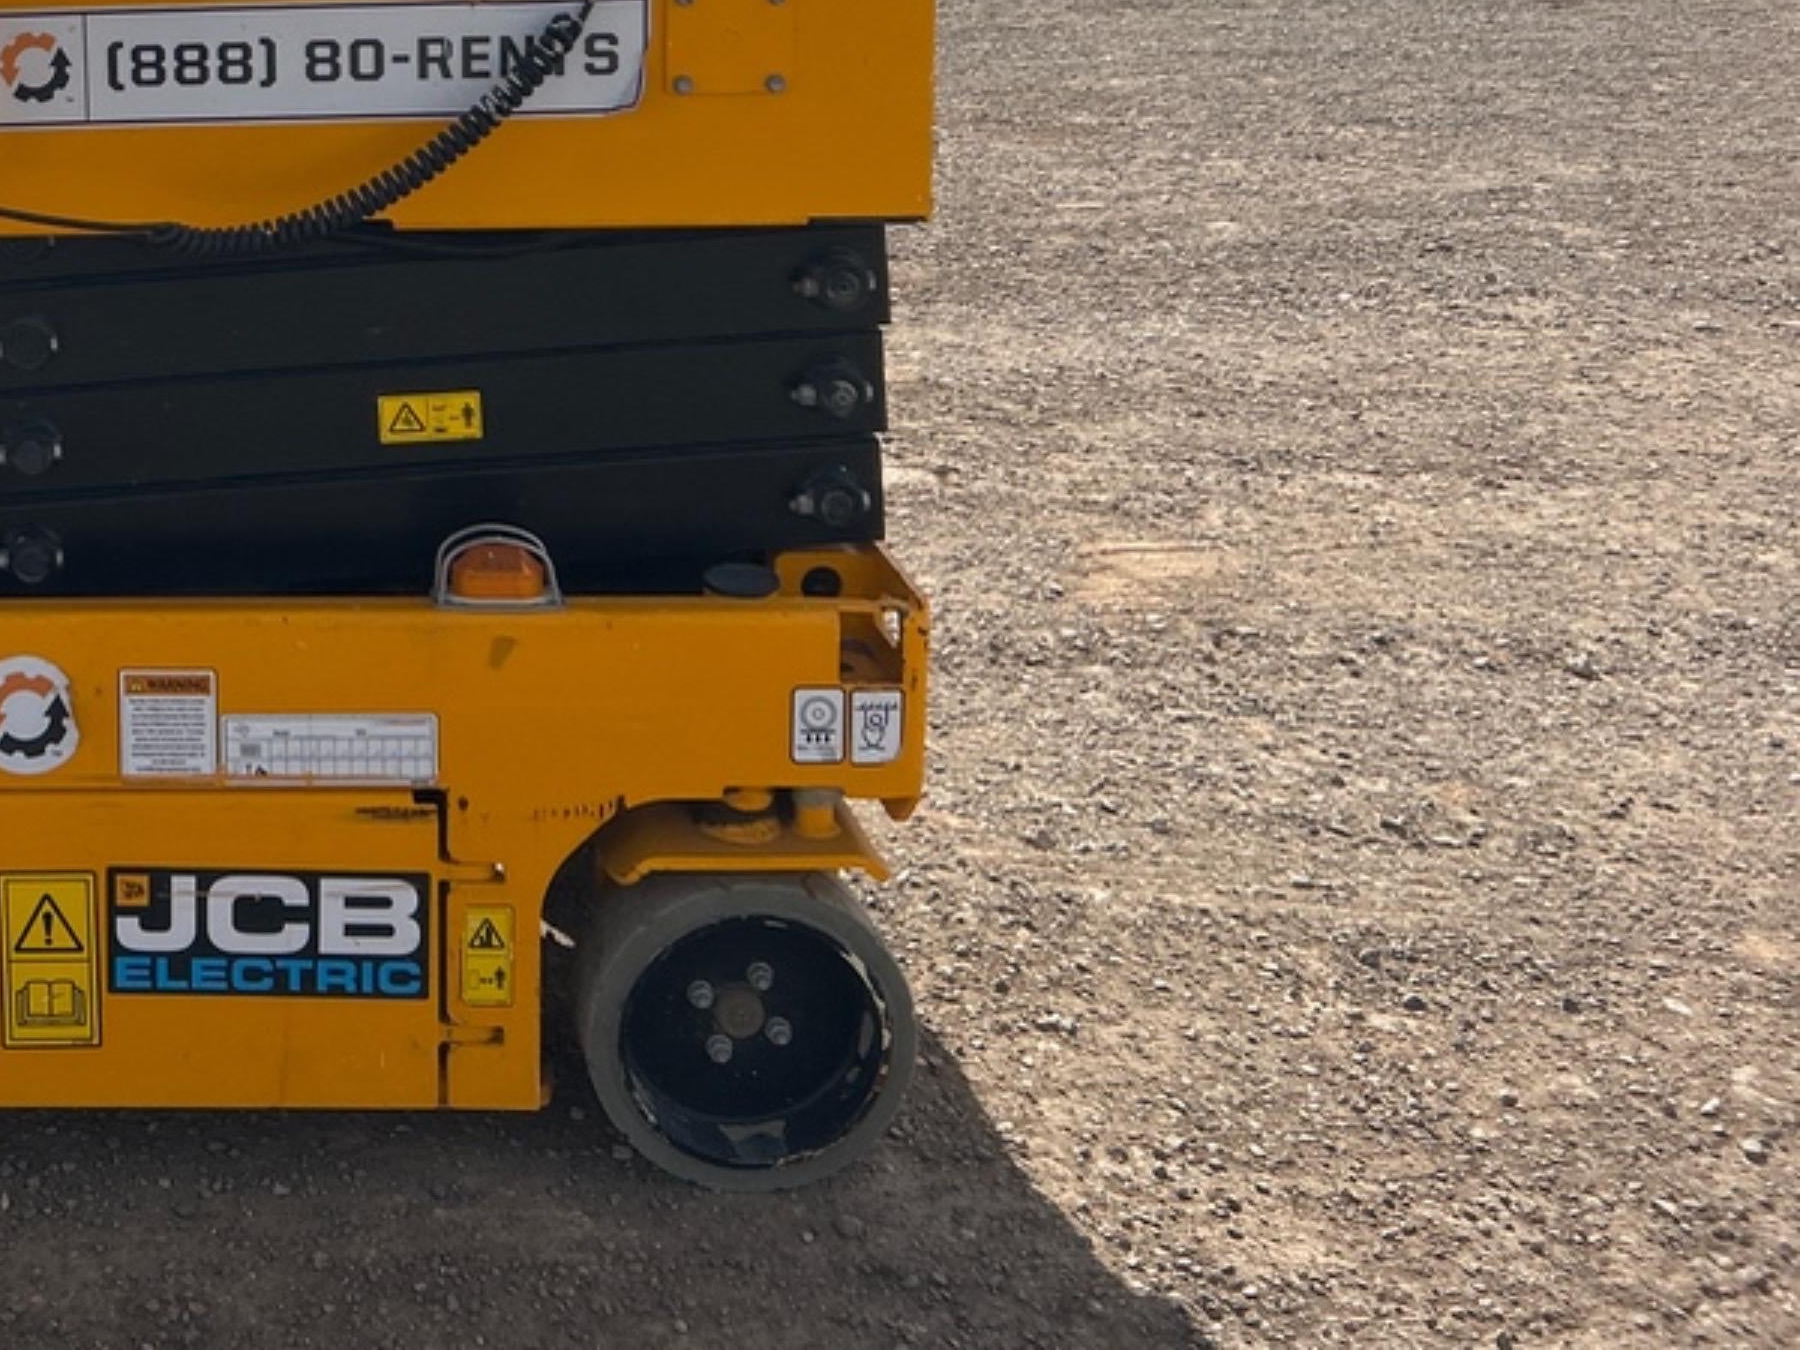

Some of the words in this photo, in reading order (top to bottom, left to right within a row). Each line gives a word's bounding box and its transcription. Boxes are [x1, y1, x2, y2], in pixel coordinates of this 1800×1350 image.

[107, 37, 278, 92] (888)
[116, 874, 421, 955] JCB
[115, 956, 422, 994] ELECTRIC
